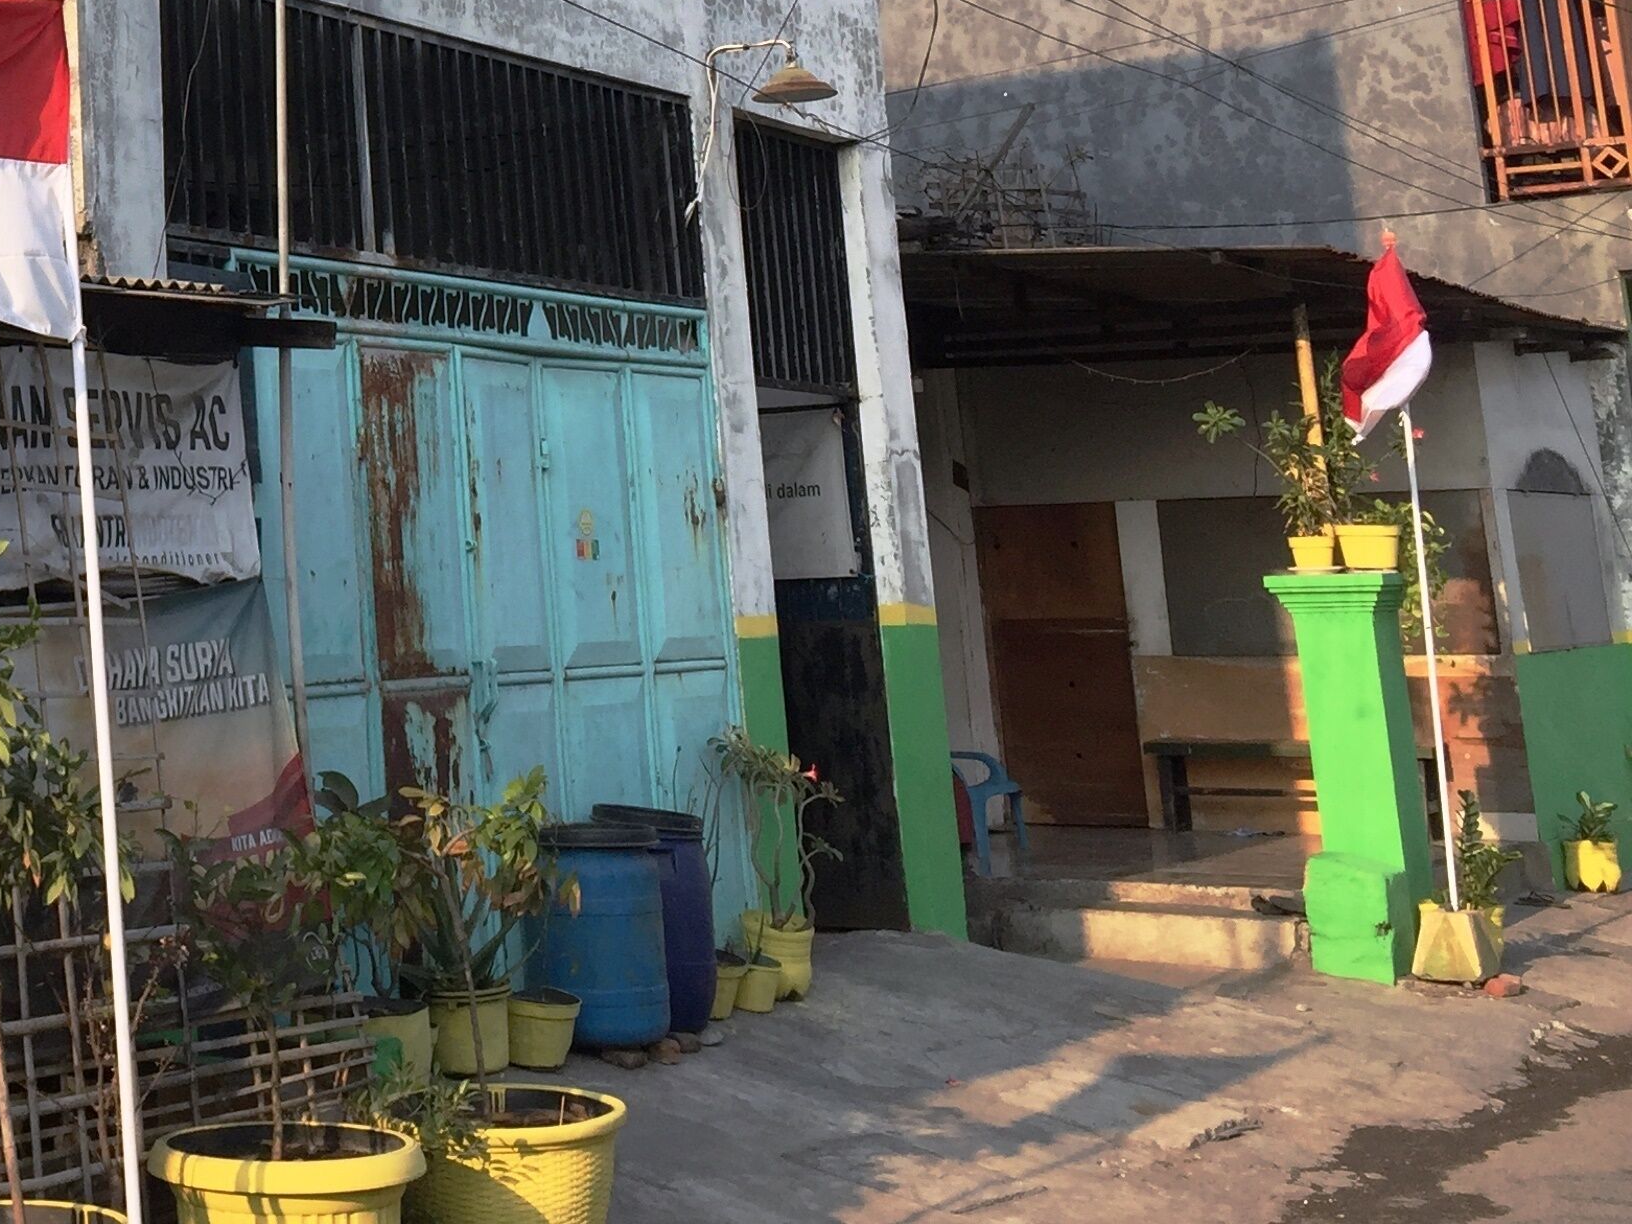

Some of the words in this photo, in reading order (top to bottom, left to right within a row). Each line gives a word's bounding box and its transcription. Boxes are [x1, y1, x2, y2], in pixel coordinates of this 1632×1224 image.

[189, 394, 231, 451] AC
[138, 467, 150, 491] &
[153, 465, 235, 491] INDUSTRI
[776, 481, 821, 499] dalam
[73, 643, 162, 692] CHAYA
[165, 637, 235, 683] SURYA
[114, 681, 225, 726] BANGKITKAN
[227, 672, 271, 710] KITA
